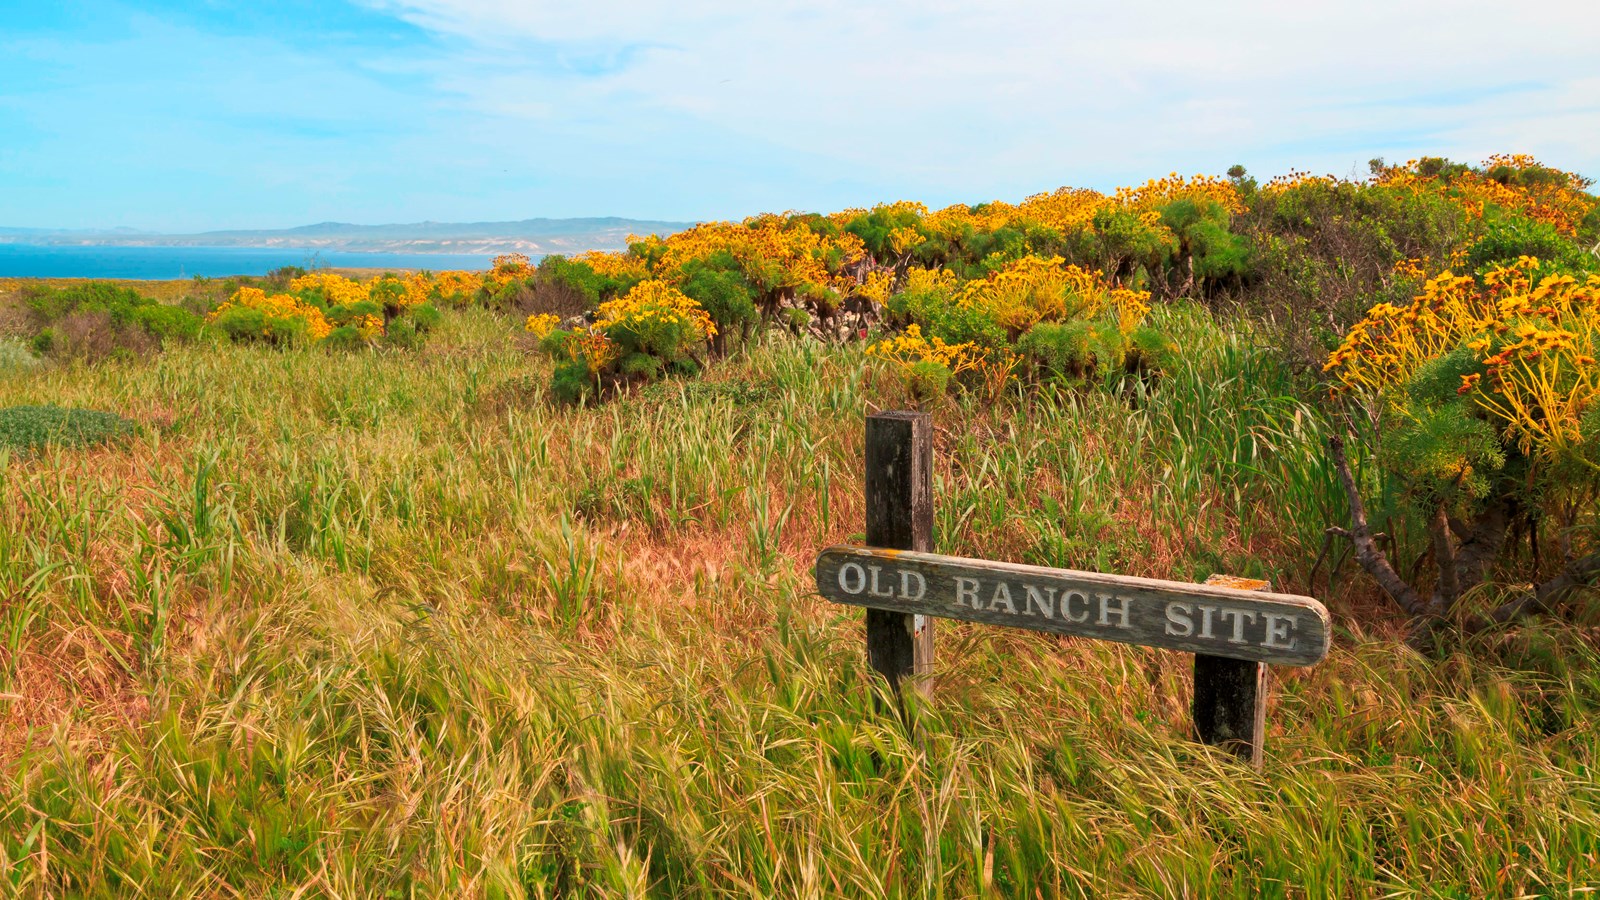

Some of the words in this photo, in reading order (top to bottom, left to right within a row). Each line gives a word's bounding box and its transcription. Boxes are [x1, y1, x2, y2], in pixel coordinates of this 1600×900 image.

[838, 562, 927, 601] OLD
[953, 576, 1133, 628] RANCH
[1165, 601, 1298, 650] SITE
